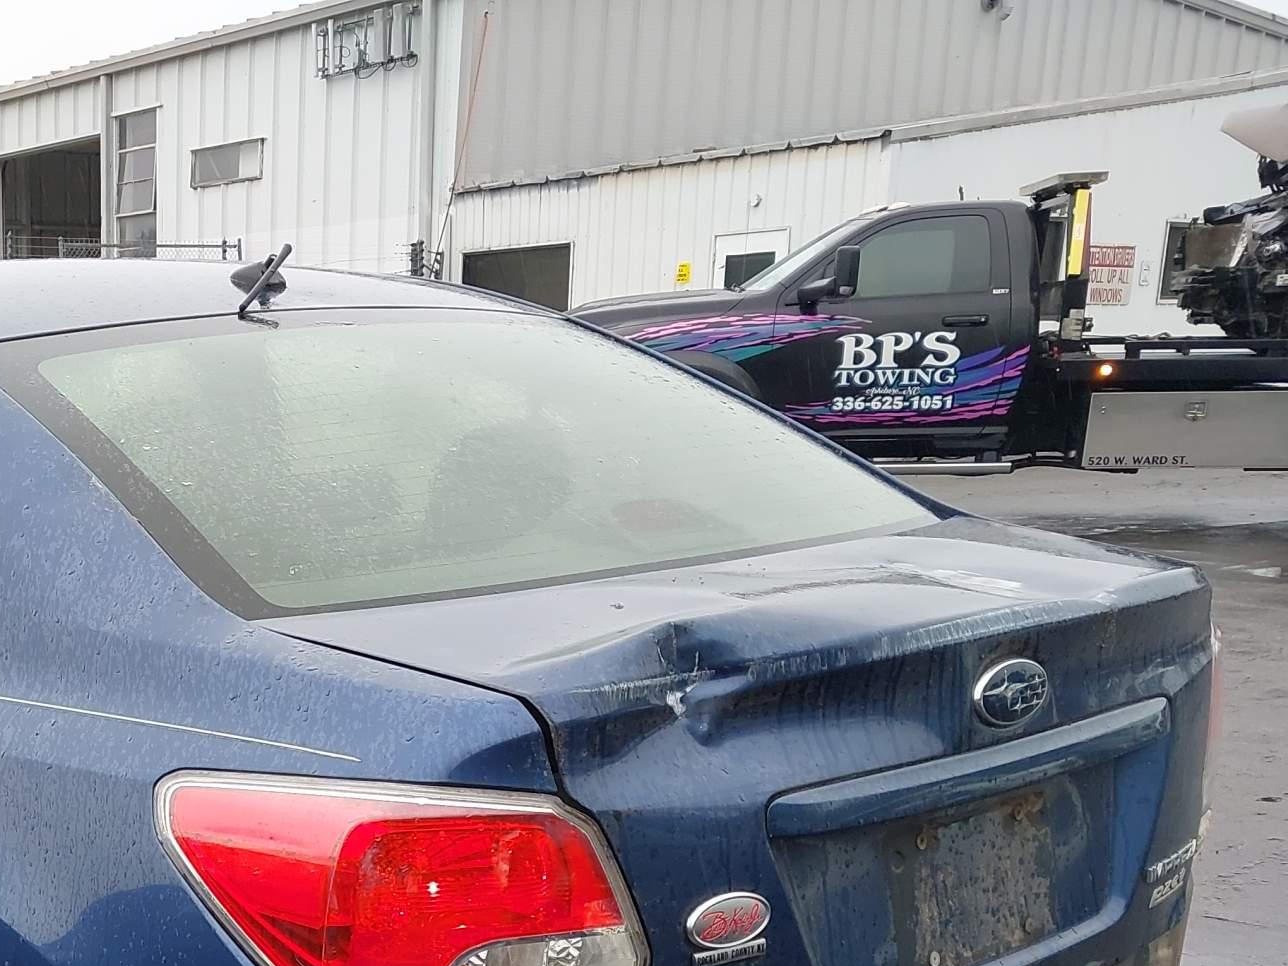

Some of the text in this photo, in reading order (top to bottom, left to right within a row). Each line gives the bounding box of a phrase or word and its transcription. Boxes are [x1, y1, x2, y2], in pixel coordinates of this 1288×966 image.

[1089, 268, 1129, 284] OLL UP ALL
[1089, 287, 1123, 303] WINDOWS
[834, 331, 961, 369] BP'S
[833, 367, 957, 386] TOWING
[831, 395, 953, 411] 336-625-1051
[1088, 455, 1189, 466] 520 W. WARD ST.
[731, 945, 755, 959] COUNTY
